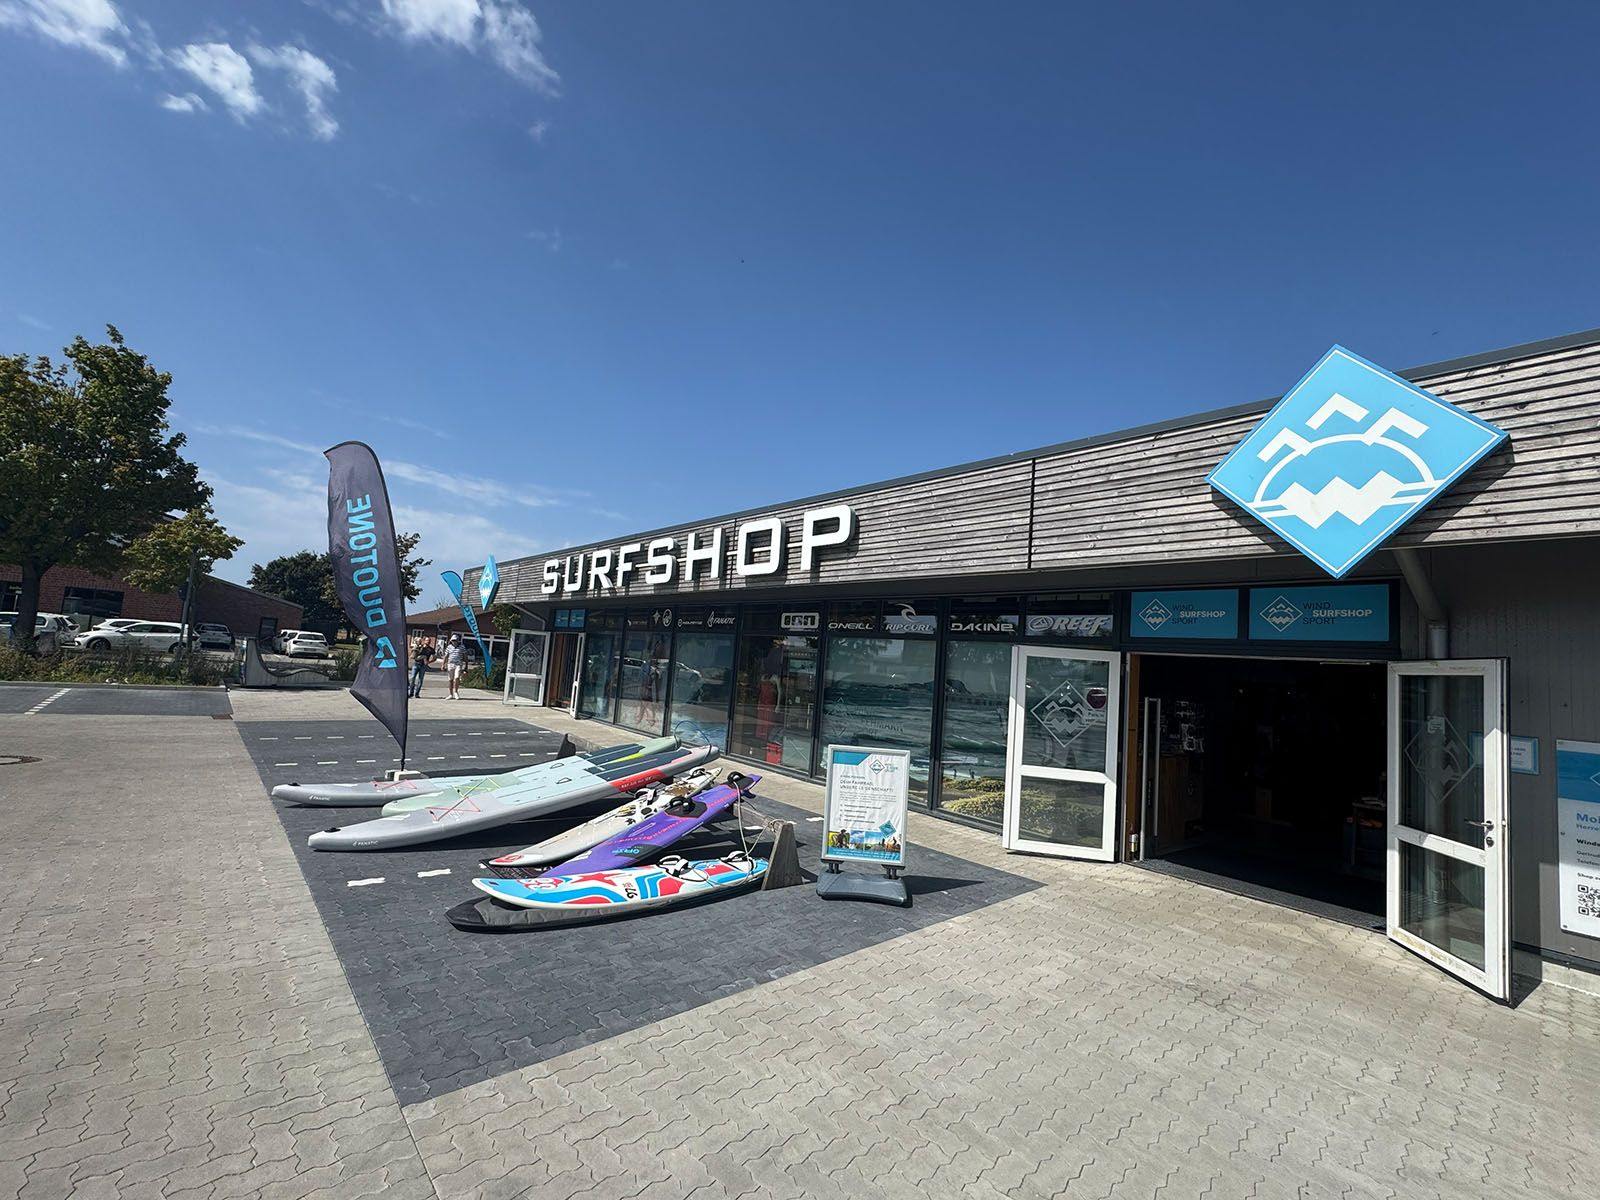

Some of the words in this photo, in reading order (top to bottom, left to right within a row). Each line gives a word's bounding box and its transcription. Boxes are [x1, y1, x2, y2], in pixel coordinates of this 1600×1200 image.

[541, 504, 854, 595] SURFSHOP
[1302, 601, 1331, 610] WIND
[1179, 610, 1226, 619] SURFSHOP
[1312, 609, 1373, 618] SURFSHOP
[1302, 616, 1336, 625] SPORT
[950, 622, 1015, 632] DAKINE
[1052, 616, 1111, 635] REEF
